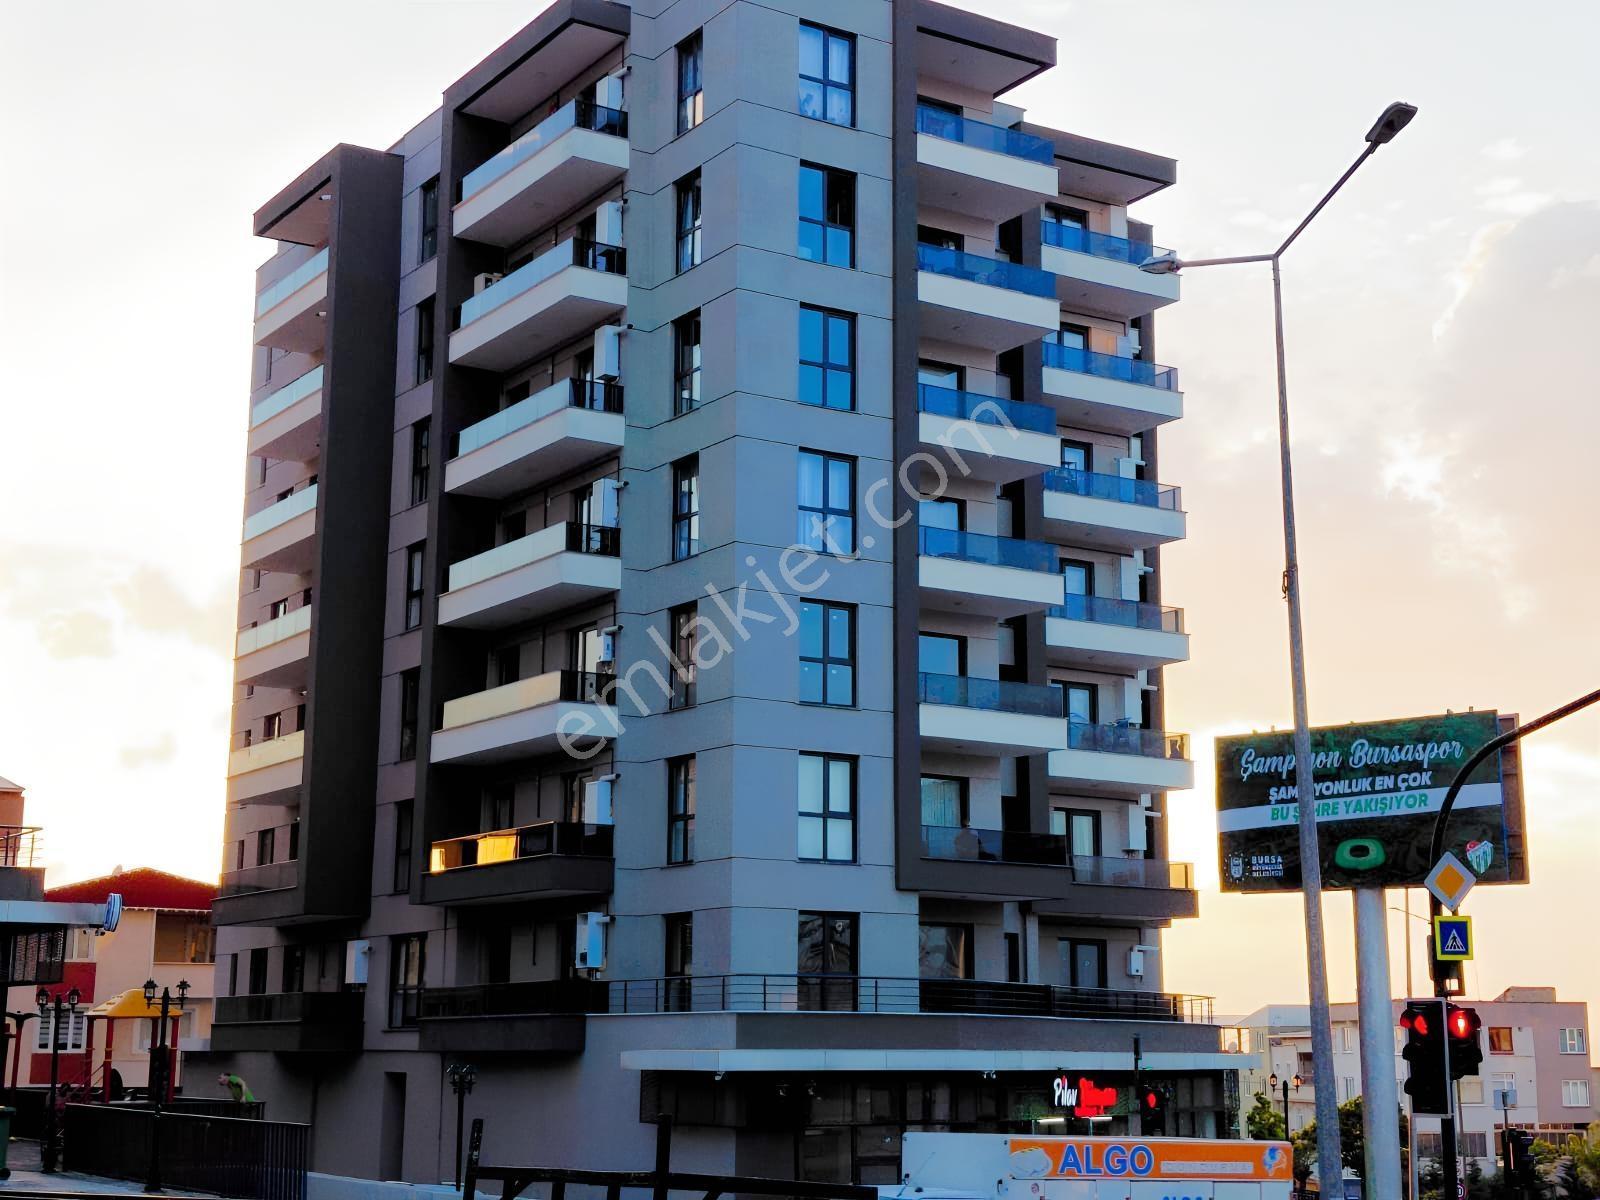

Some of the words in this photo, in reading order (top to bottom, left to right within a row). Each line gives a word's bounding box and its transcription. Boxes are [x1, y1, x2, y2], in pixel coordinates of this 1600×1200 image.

[1349, 738, 1464, 769] Bursaspor
[1269, 776, 1372, 805] ŞAMYONLUK
[1375, 775, 1395, 791] EN
[1397, 771, 1433, 791] ÇOK
[1271, 806, 1290, 821] BU
[1344, 793, 1429, 815] YAKIŞIYOR
[1251, 855, 1283, 864] BURSA
[1053, 1075, 1078, 1107] Pilav
[1058, 1143, 1154, 1176] ALGO
